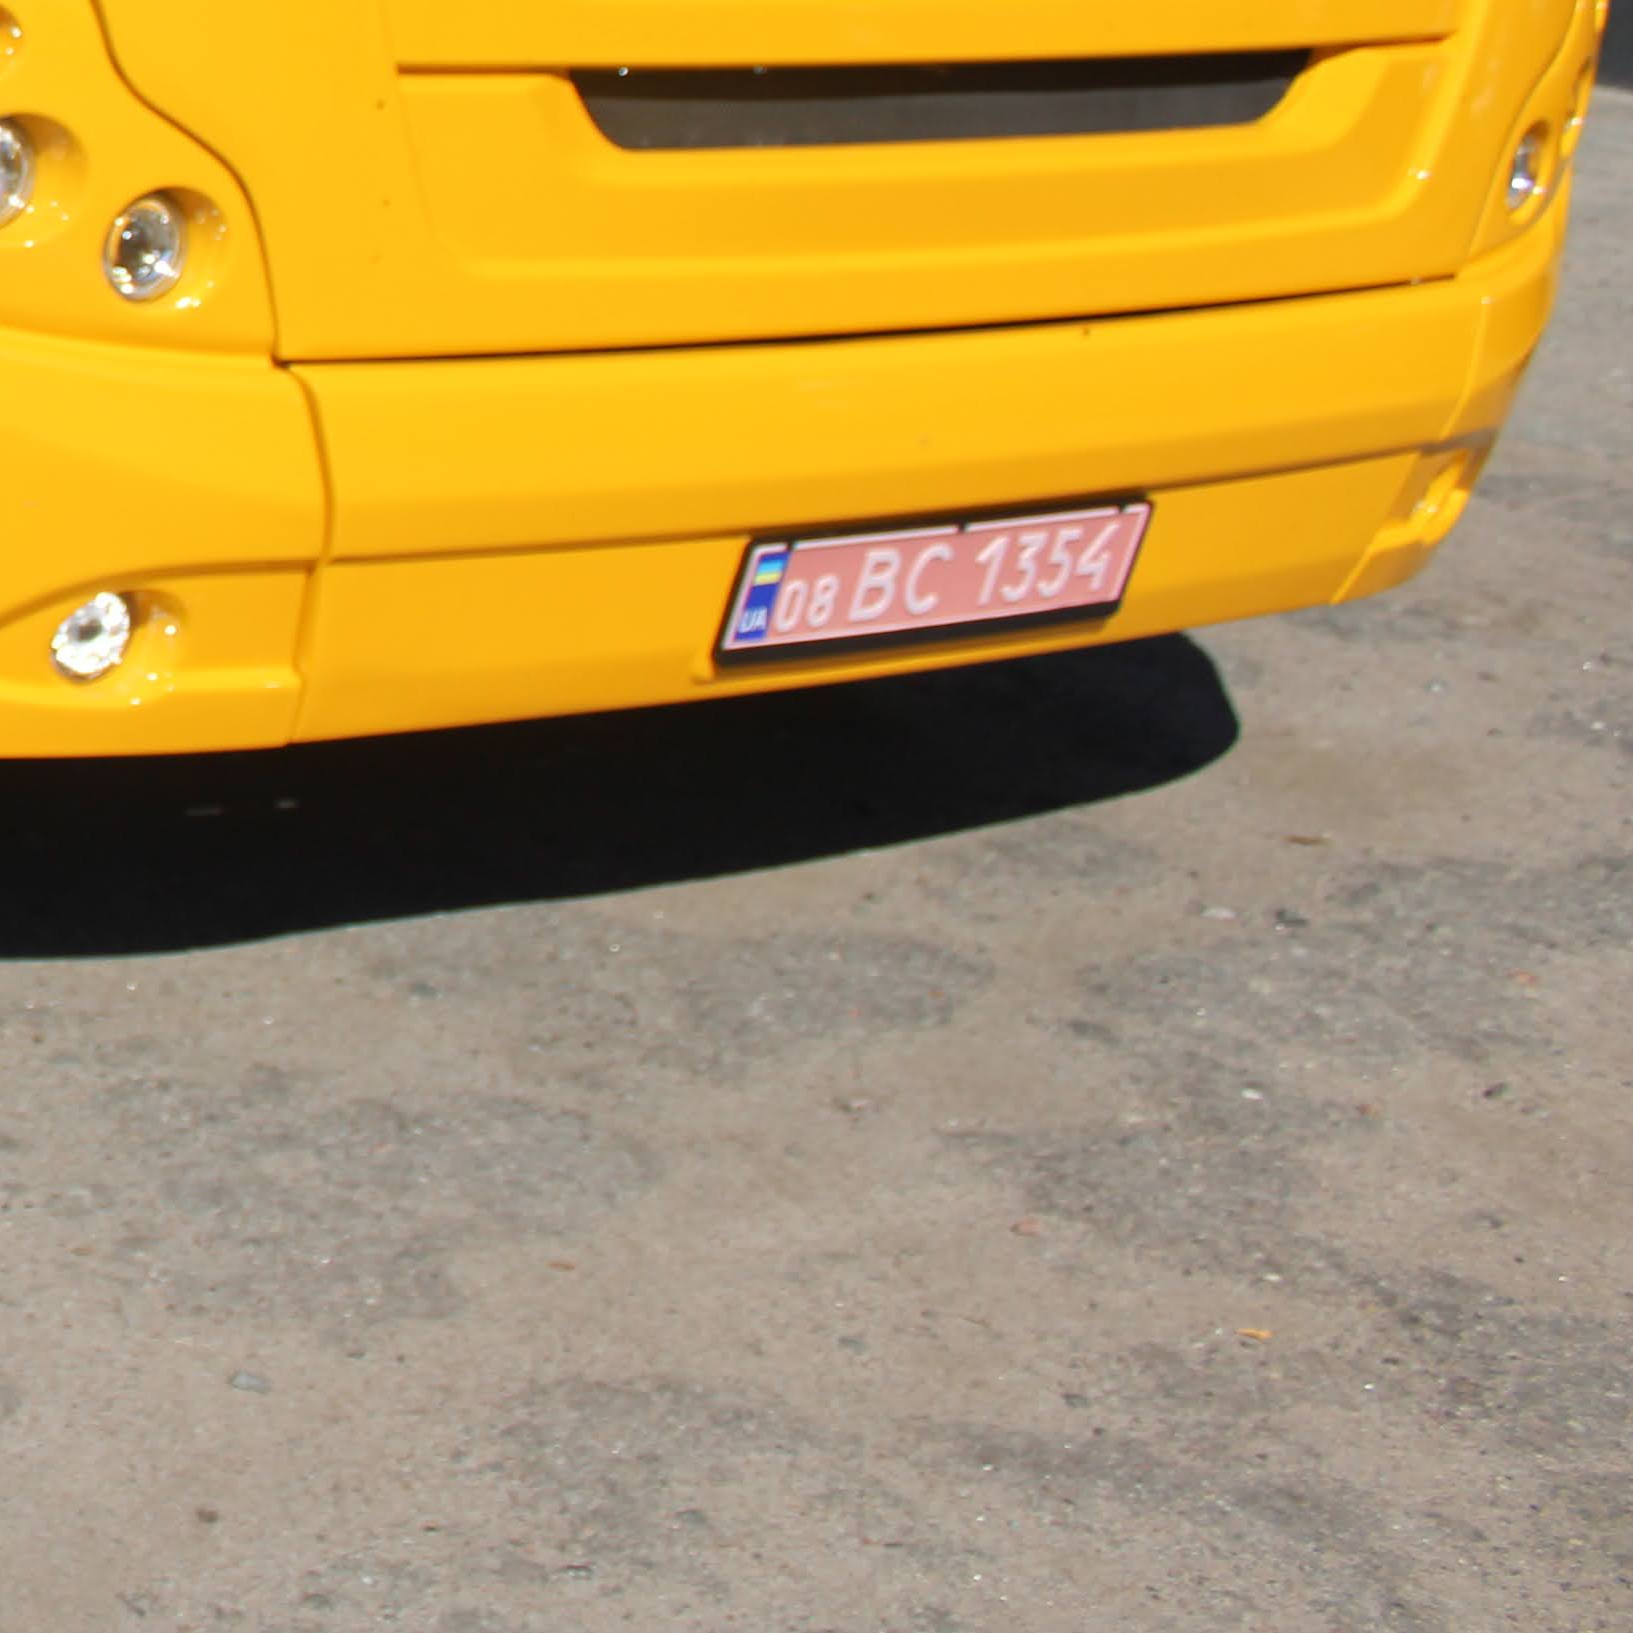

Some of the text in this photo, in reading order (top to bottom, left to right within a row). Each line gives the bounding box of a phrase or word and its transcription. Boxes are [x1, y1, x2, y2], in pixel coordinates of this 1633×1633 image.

[774, 520, 1122, 632] 08 BC 1354
[737, 605, 767, 634] UA
